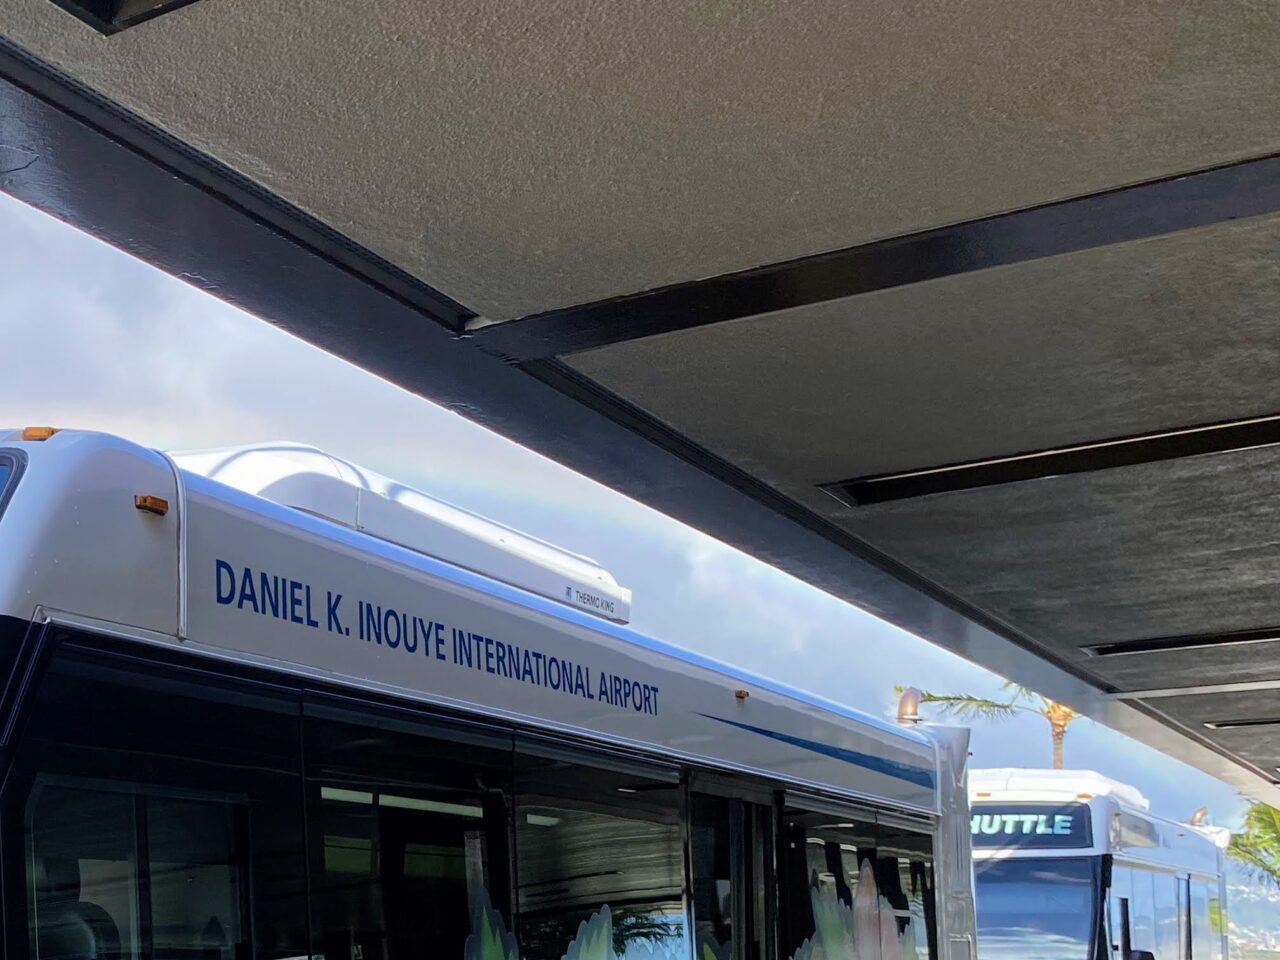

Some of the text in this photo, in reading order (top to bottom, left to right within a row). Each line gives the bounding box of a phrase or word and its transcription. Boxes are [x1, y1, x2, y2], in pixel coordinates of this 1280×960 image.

[215, 559, 659, 716] DANIEL K. INOUYE INTERNATIONAL AIRPORT
[575, 590, 615, 613] THERMO KING
